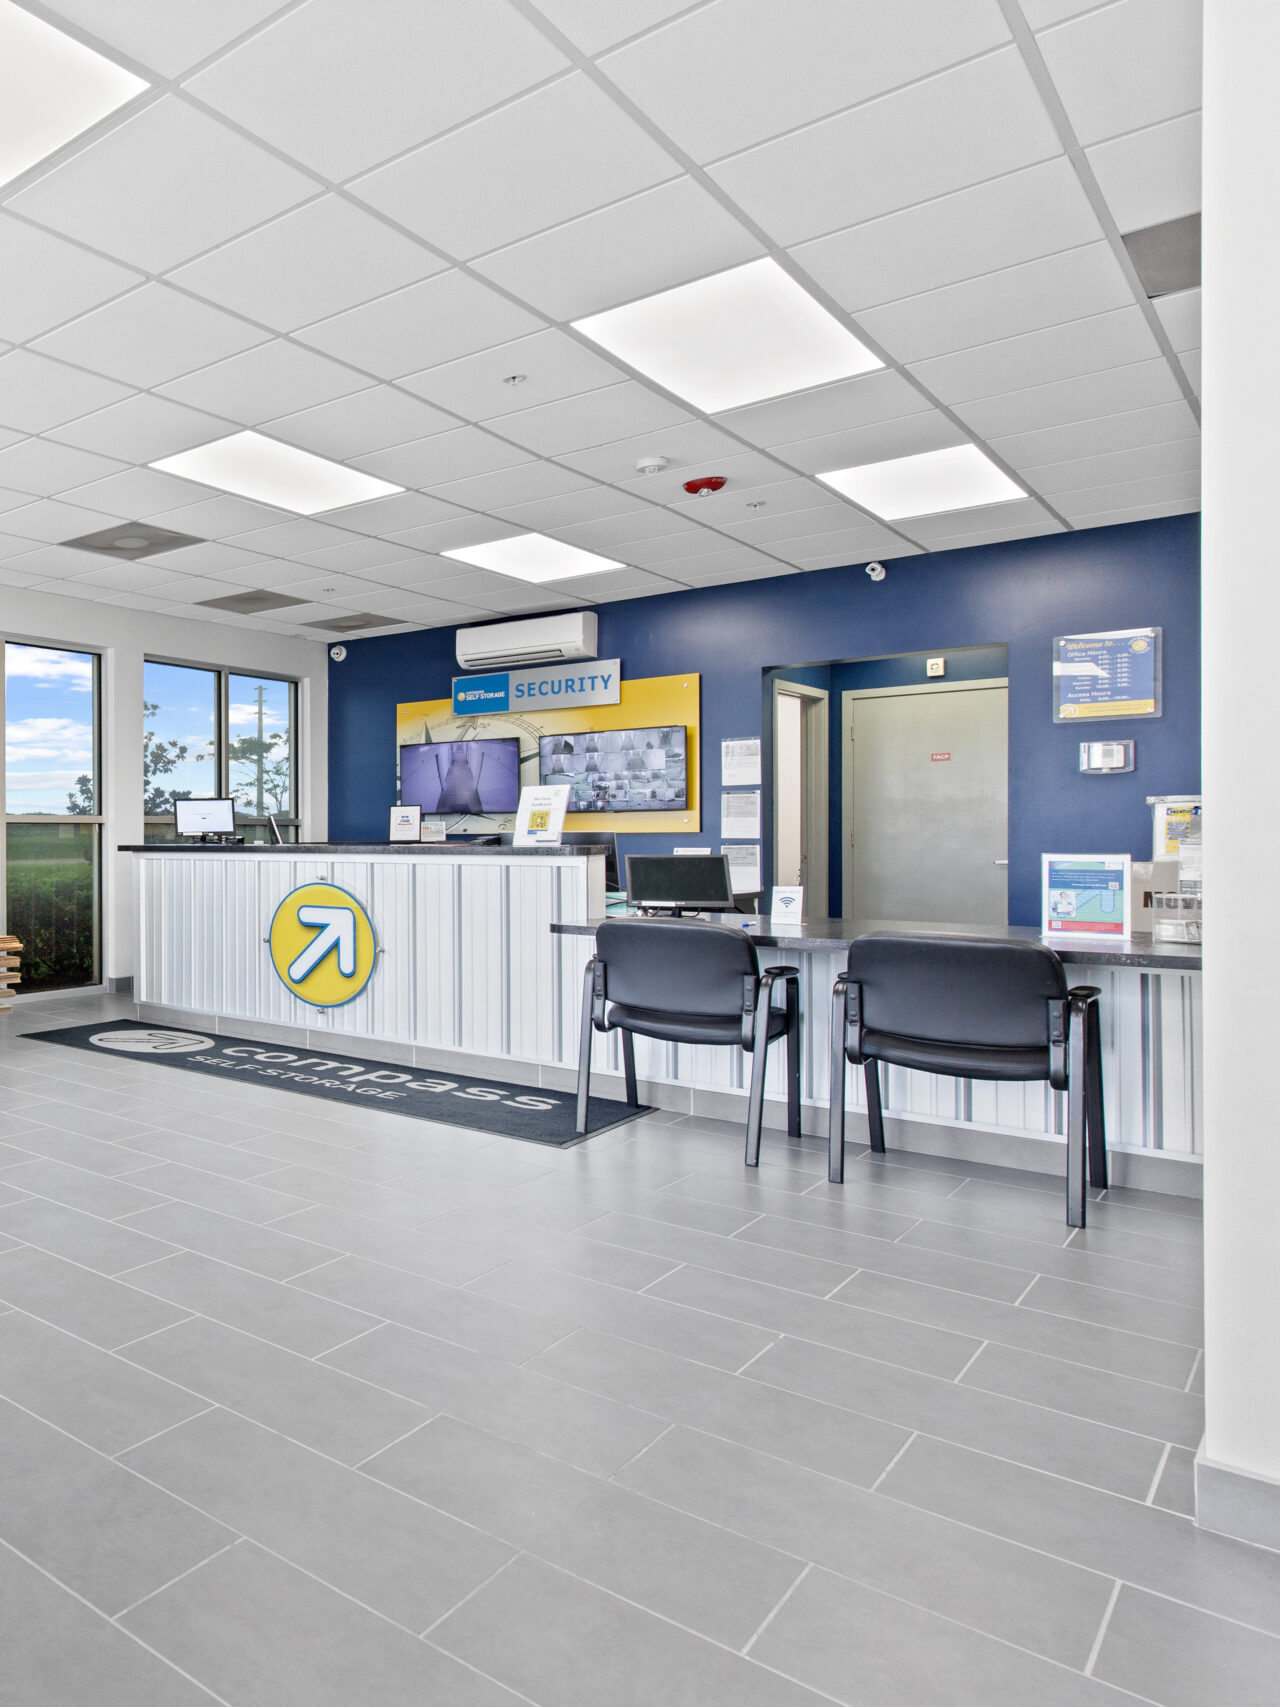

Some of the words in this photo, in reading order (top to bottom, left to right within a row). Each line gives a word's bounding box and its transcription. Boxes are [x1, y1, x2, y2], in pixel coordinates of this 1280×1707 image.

[465, 693, 479, 701] SELF
[480, 691, 506, 699] STORAGE
[514, 673, 612, 699] SECURITY
[186, 1054, 263, 1071] SELF
[257, 1068, 408, 1101] STORAGE
[221, 1046, 563, 1111] compass
